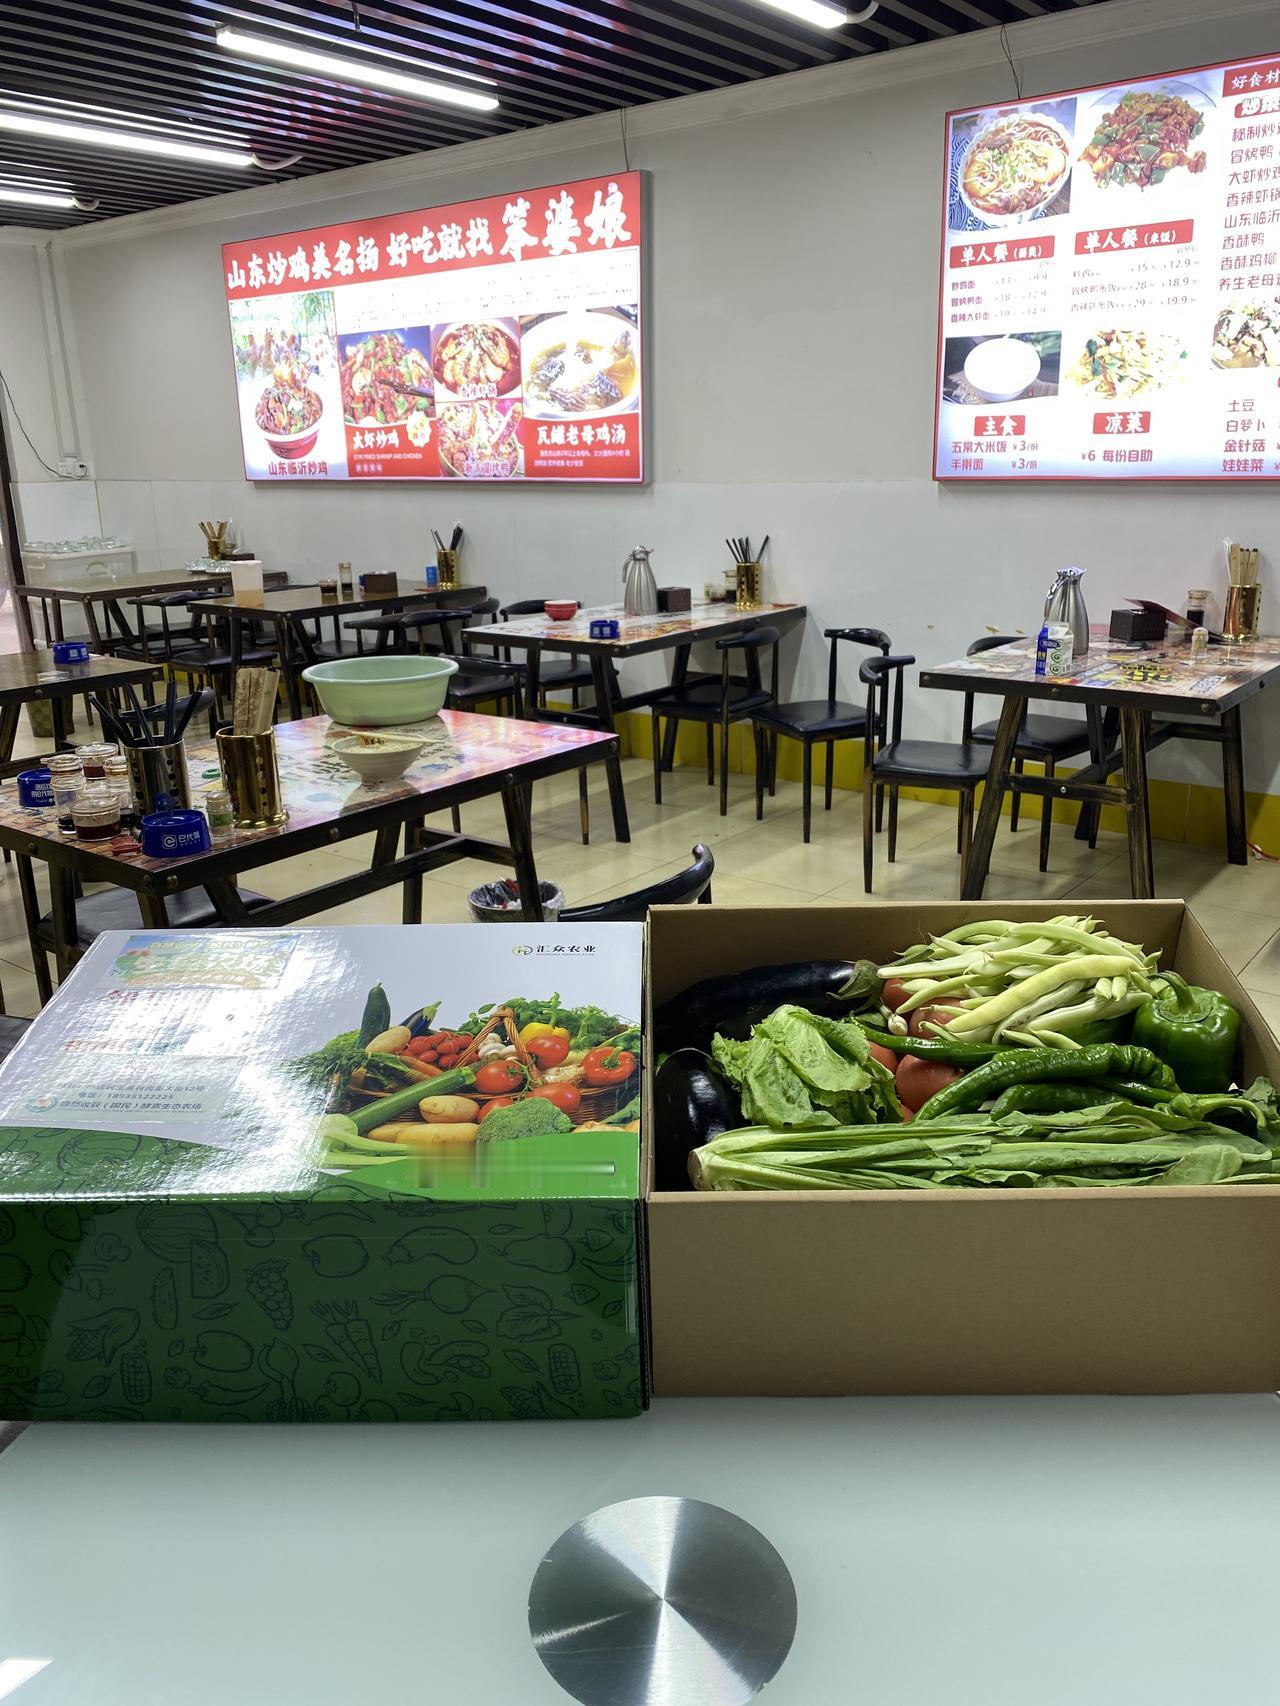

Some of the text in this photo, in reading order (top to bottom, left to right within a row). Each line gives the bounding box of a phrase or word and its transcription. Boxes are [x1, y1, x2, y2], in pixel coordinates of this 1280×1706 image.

[1232, 122, 1280, 142] 秘制炒
[1231, 145, 1273, 164] 冒烤鸭
[1224, 208, 1280, 229] 山东临沂
[386, 217, 494, 268] 好吃就找
[1222, 232, 1265, 250] 香酥鸭
[1220, 252, 1277, 271] 香酥鸡柳
[1227, 399, 1256, 412] 土豆
[982, 415, 1018, 437] 主食
[1226, 419, 1266, 432] 白萝卜
[352, 428, 400, 450] 大虾炒鸡
[952, 441, 1007, 454] 五常大米饭
[1224, 439, 1266, 453] 金针菇
[1102, 449, 1153, 462] 每份自助
[268, 461, 328, 476] 山东临沂炒鸡
[1222, 459, 1264, 472] 娃娃菜
